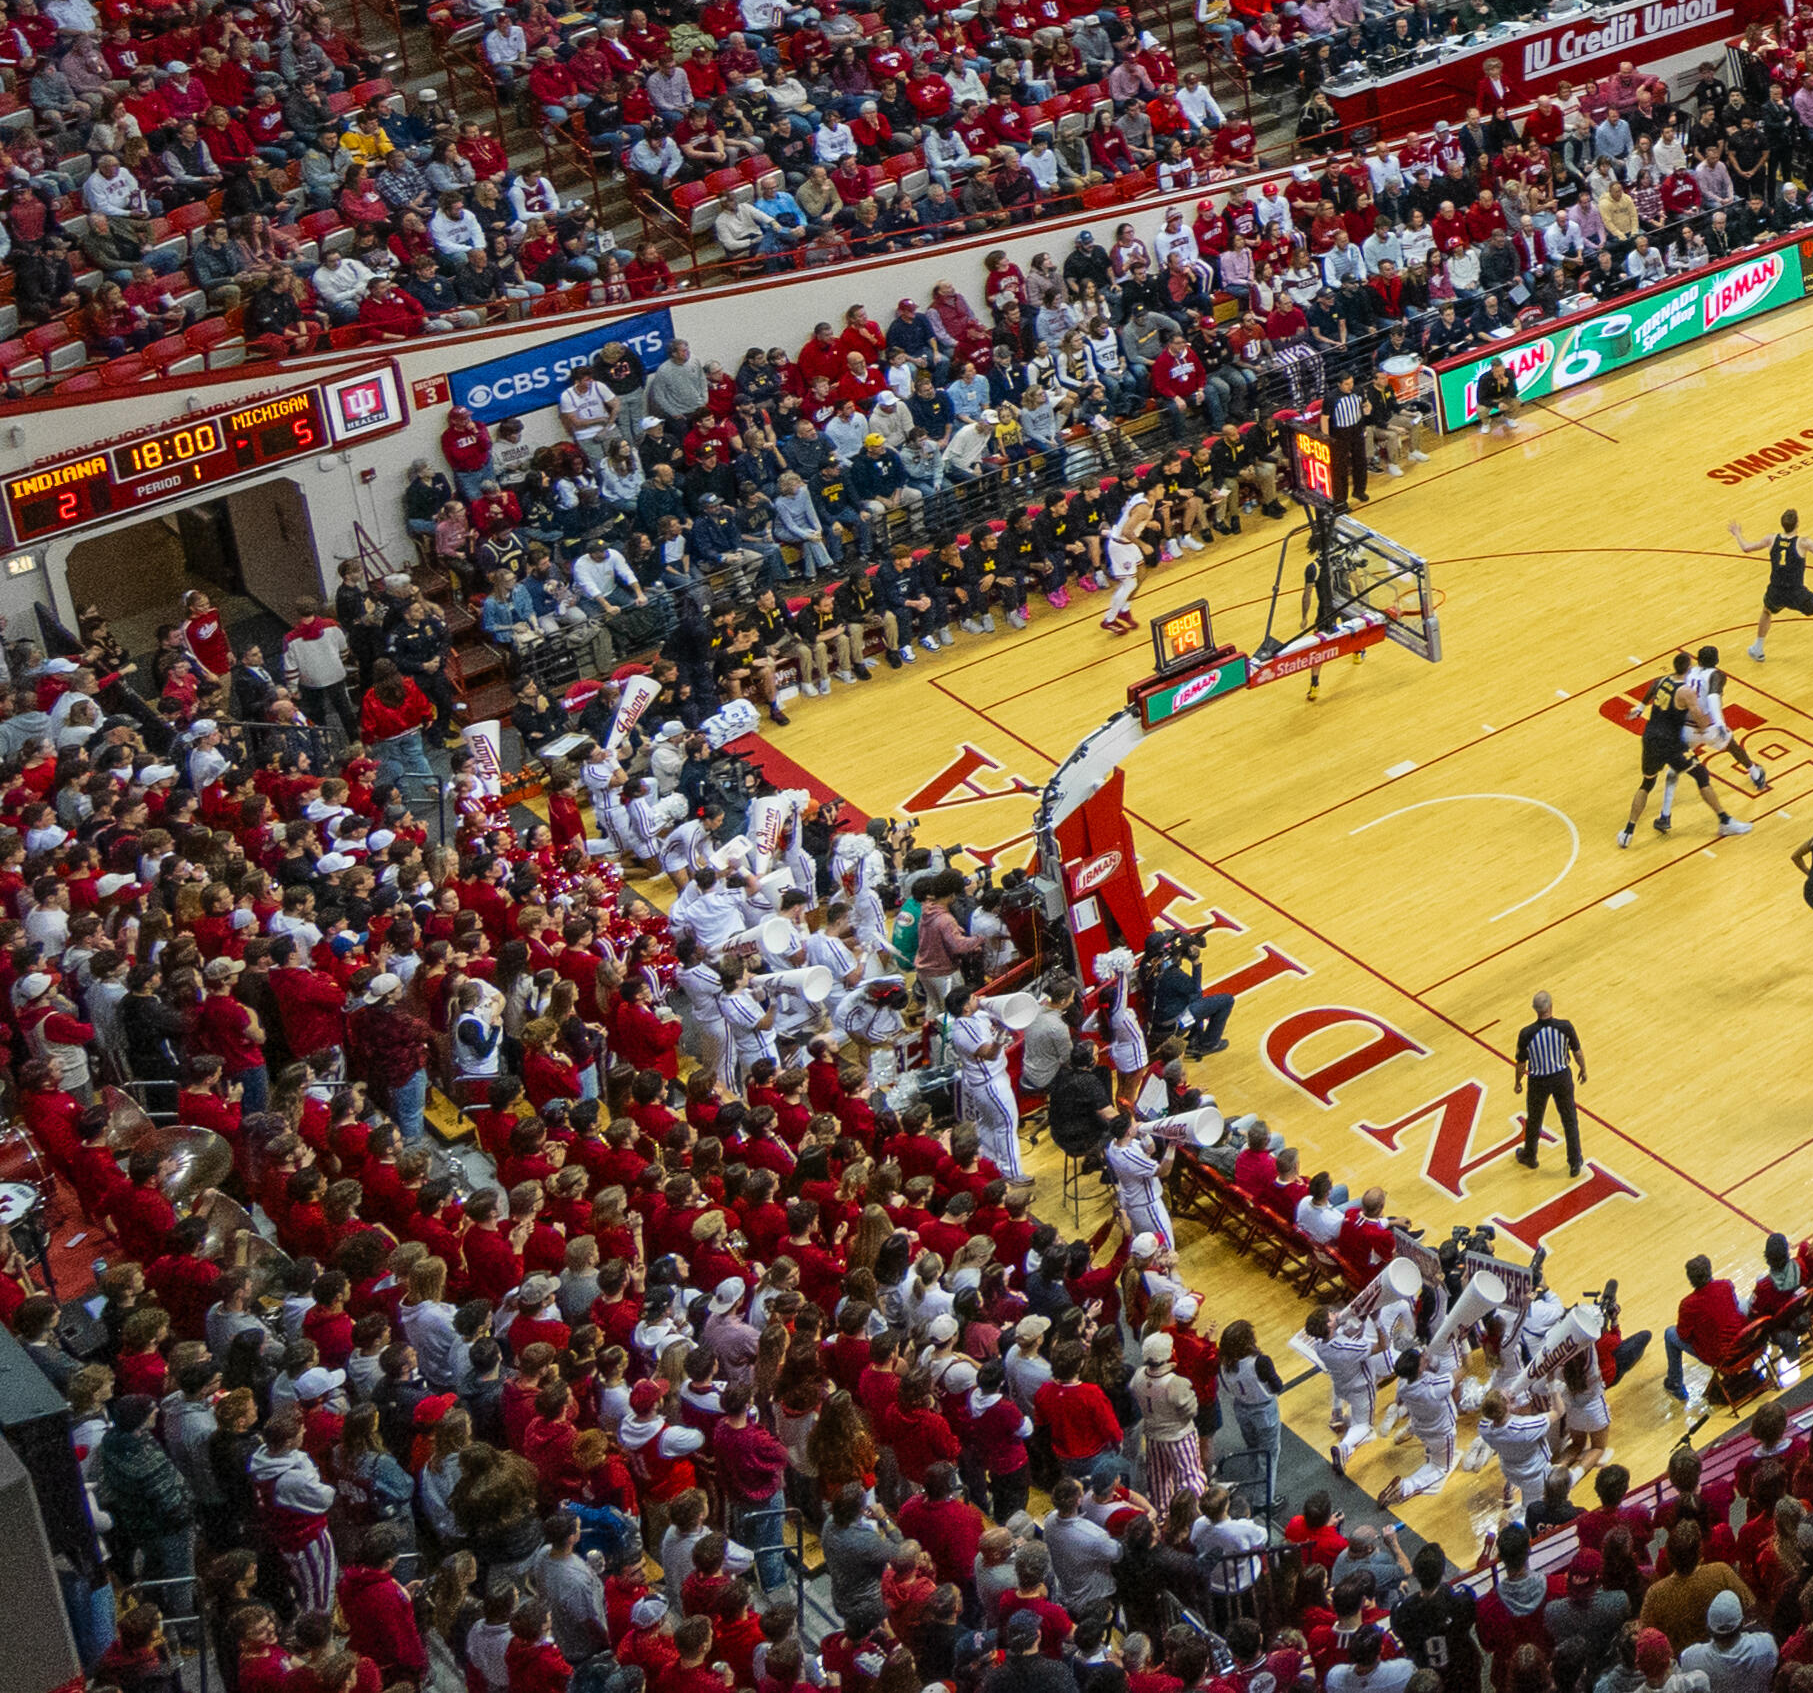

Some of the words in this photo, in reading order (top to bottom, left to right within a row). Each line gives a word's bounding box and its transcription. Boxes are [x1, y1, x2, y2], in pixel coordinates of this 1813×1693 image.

[1524, 39, 1551, 75] IU
[1557, 14, 1637, 64] Credit
[1634, 284, 1699, 343] TORNADO
[1703, 259, 1776, 331] LIBMAN
[1641, 322, 1668, 353] Spin
[1669, 303, 1696, 334] Mop
[414, 377, 444, 390] SECTION
[492, 367, 550, 400] CBS
[554, 331, 663, 383] SPTS
[1464, 343, 1546, 421] LAN
[231, 394, 309, 430] MICHIGAN
[426, 386, 438, 404] 3
[293, 419, 313, 445] 5
[347, 411, 387, 429] HEALTH
[131, 425, 216, 470] 18:00
[1707, 438, 1811, 485] SIMON
[12, 456, 107, 499] INDIANA
[136, 475, 181, 497] PERIOD
[193, 464, 201, 480] 1
[59, 492, 78, 520] 2
[1779, 549, 1787, 565] 1
[1166, 610, 1201, 637] 18:00
[1176, 631, 1197, 654] 19
[617, 688, 649, 737] Indiana
[1173, 672, 1217, 712] LIBMAN
[471, 734, 499, 781] Indiana
[757, 807, 782, 855] Indiana
[1077, 855, 1118, 889] LIBMAN
[902, 743, 1646, 1256] INDIA
[1527, 1334, 1579, 1381] Indiana
